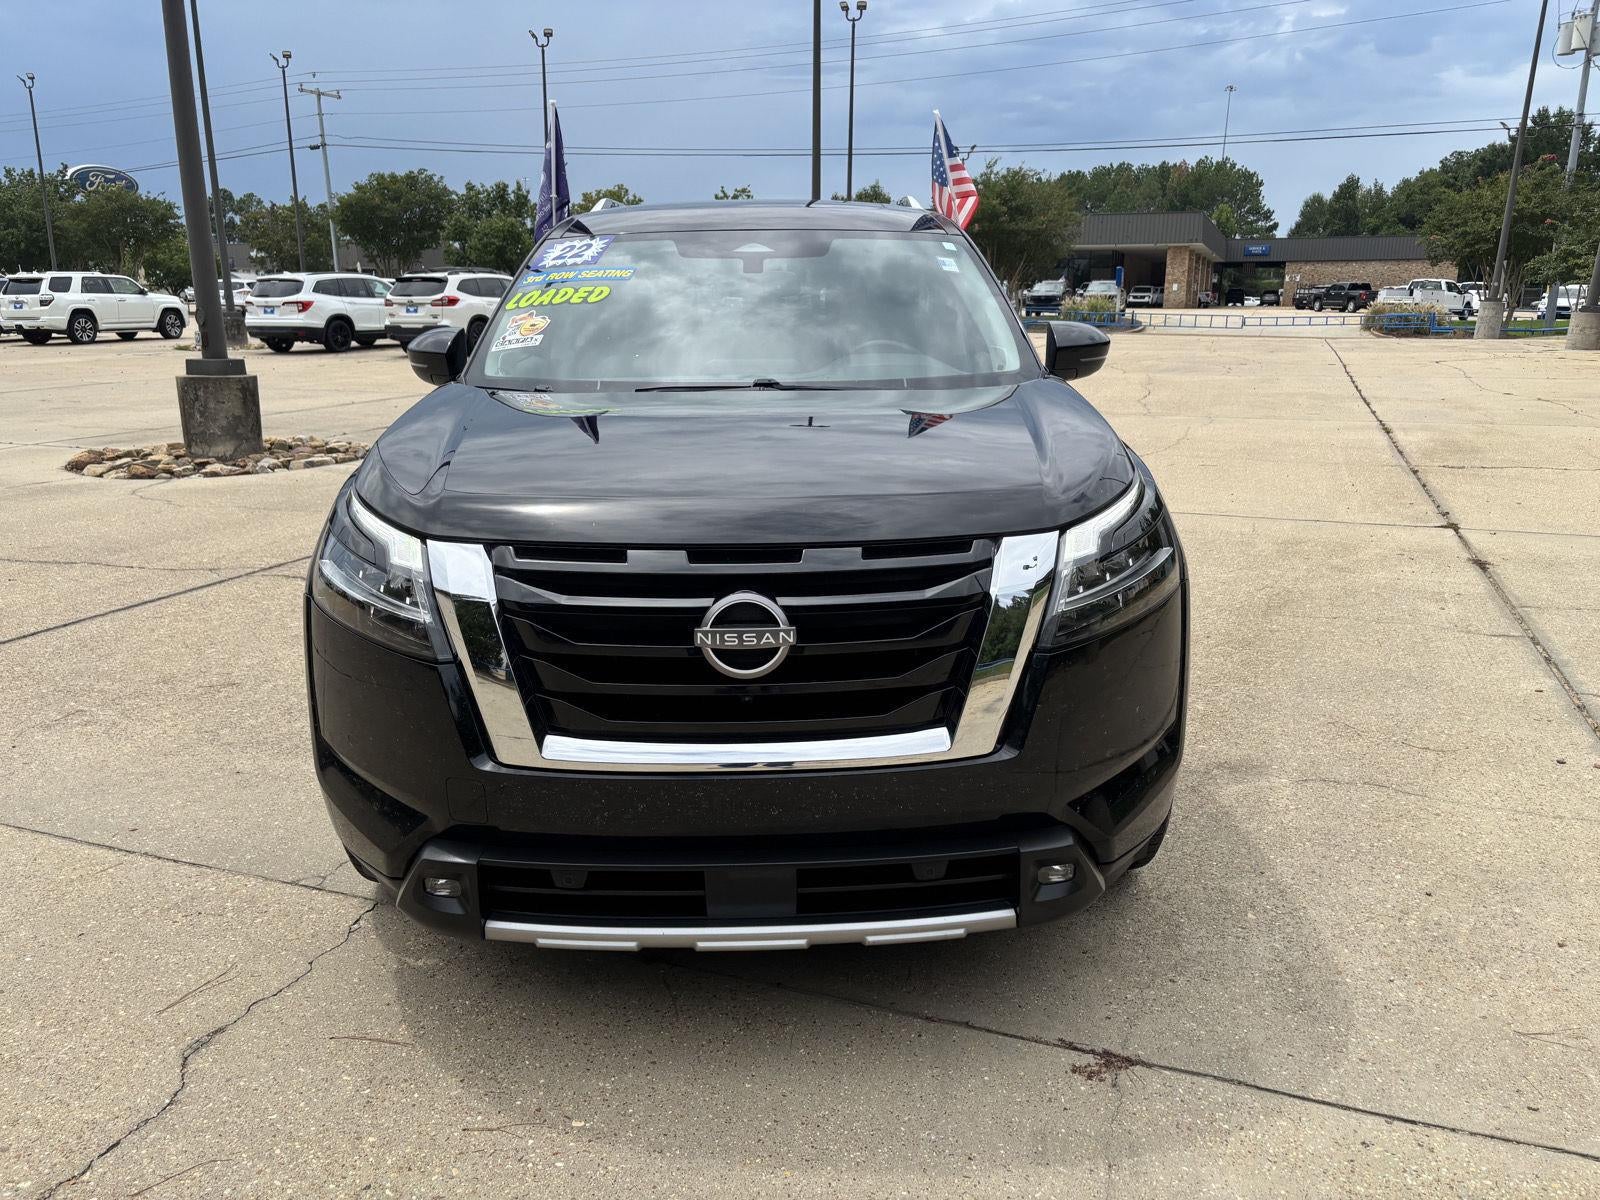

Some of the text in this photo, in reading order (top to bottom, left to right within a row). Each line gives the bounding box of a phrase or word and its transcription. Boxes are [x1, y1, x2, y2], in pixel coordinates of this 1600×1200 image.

[551, 242, 594, 261] 22
[523, 269, 634, 284] 3rd ROW SEATING
[505, 286, 611, 310] LOADED
[697, 630, 794, 645] NISSAN
